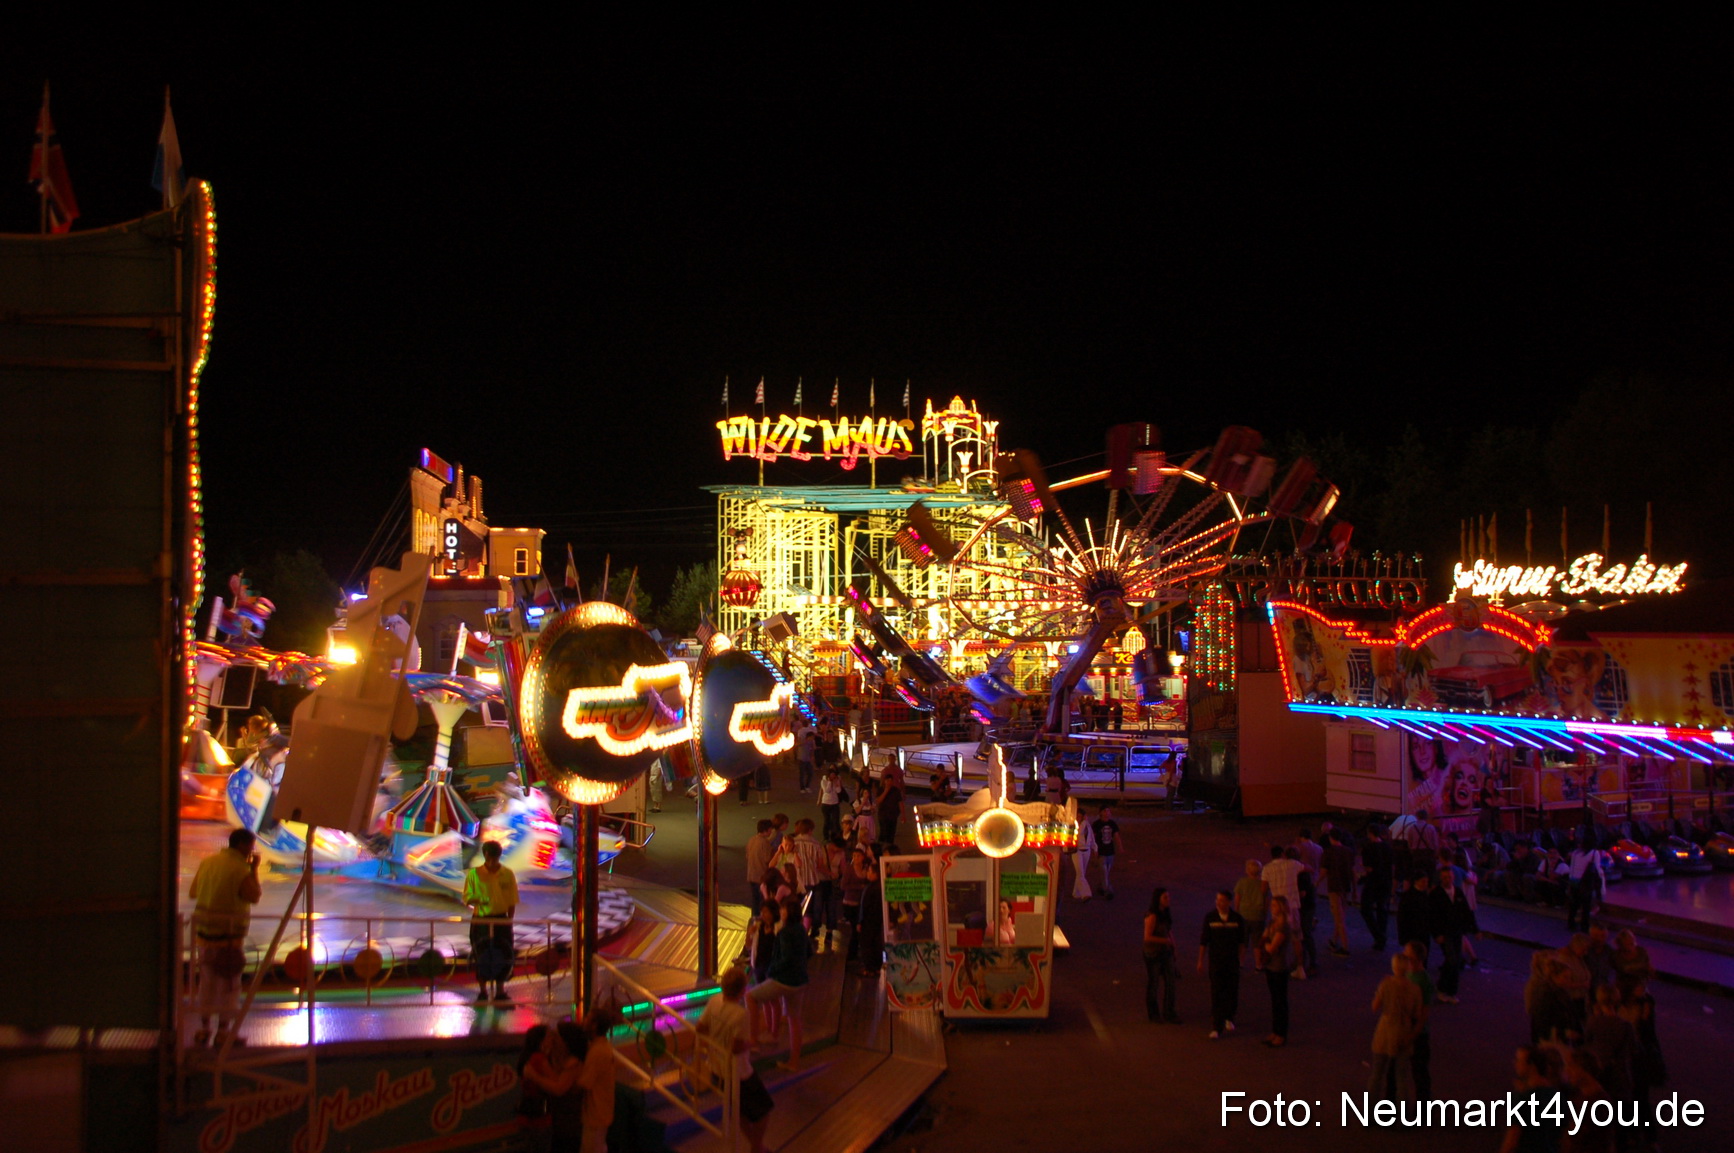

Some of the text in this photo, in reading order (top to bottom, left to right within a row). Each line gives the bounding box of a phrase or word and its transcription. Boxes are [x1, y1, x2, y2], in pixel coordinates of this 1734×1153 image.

[716, 413, 914, 470] WILDE MAUS
[294, 1068, 433, 1153] Moskau
[432, 1061, 516, 1130] Paris
